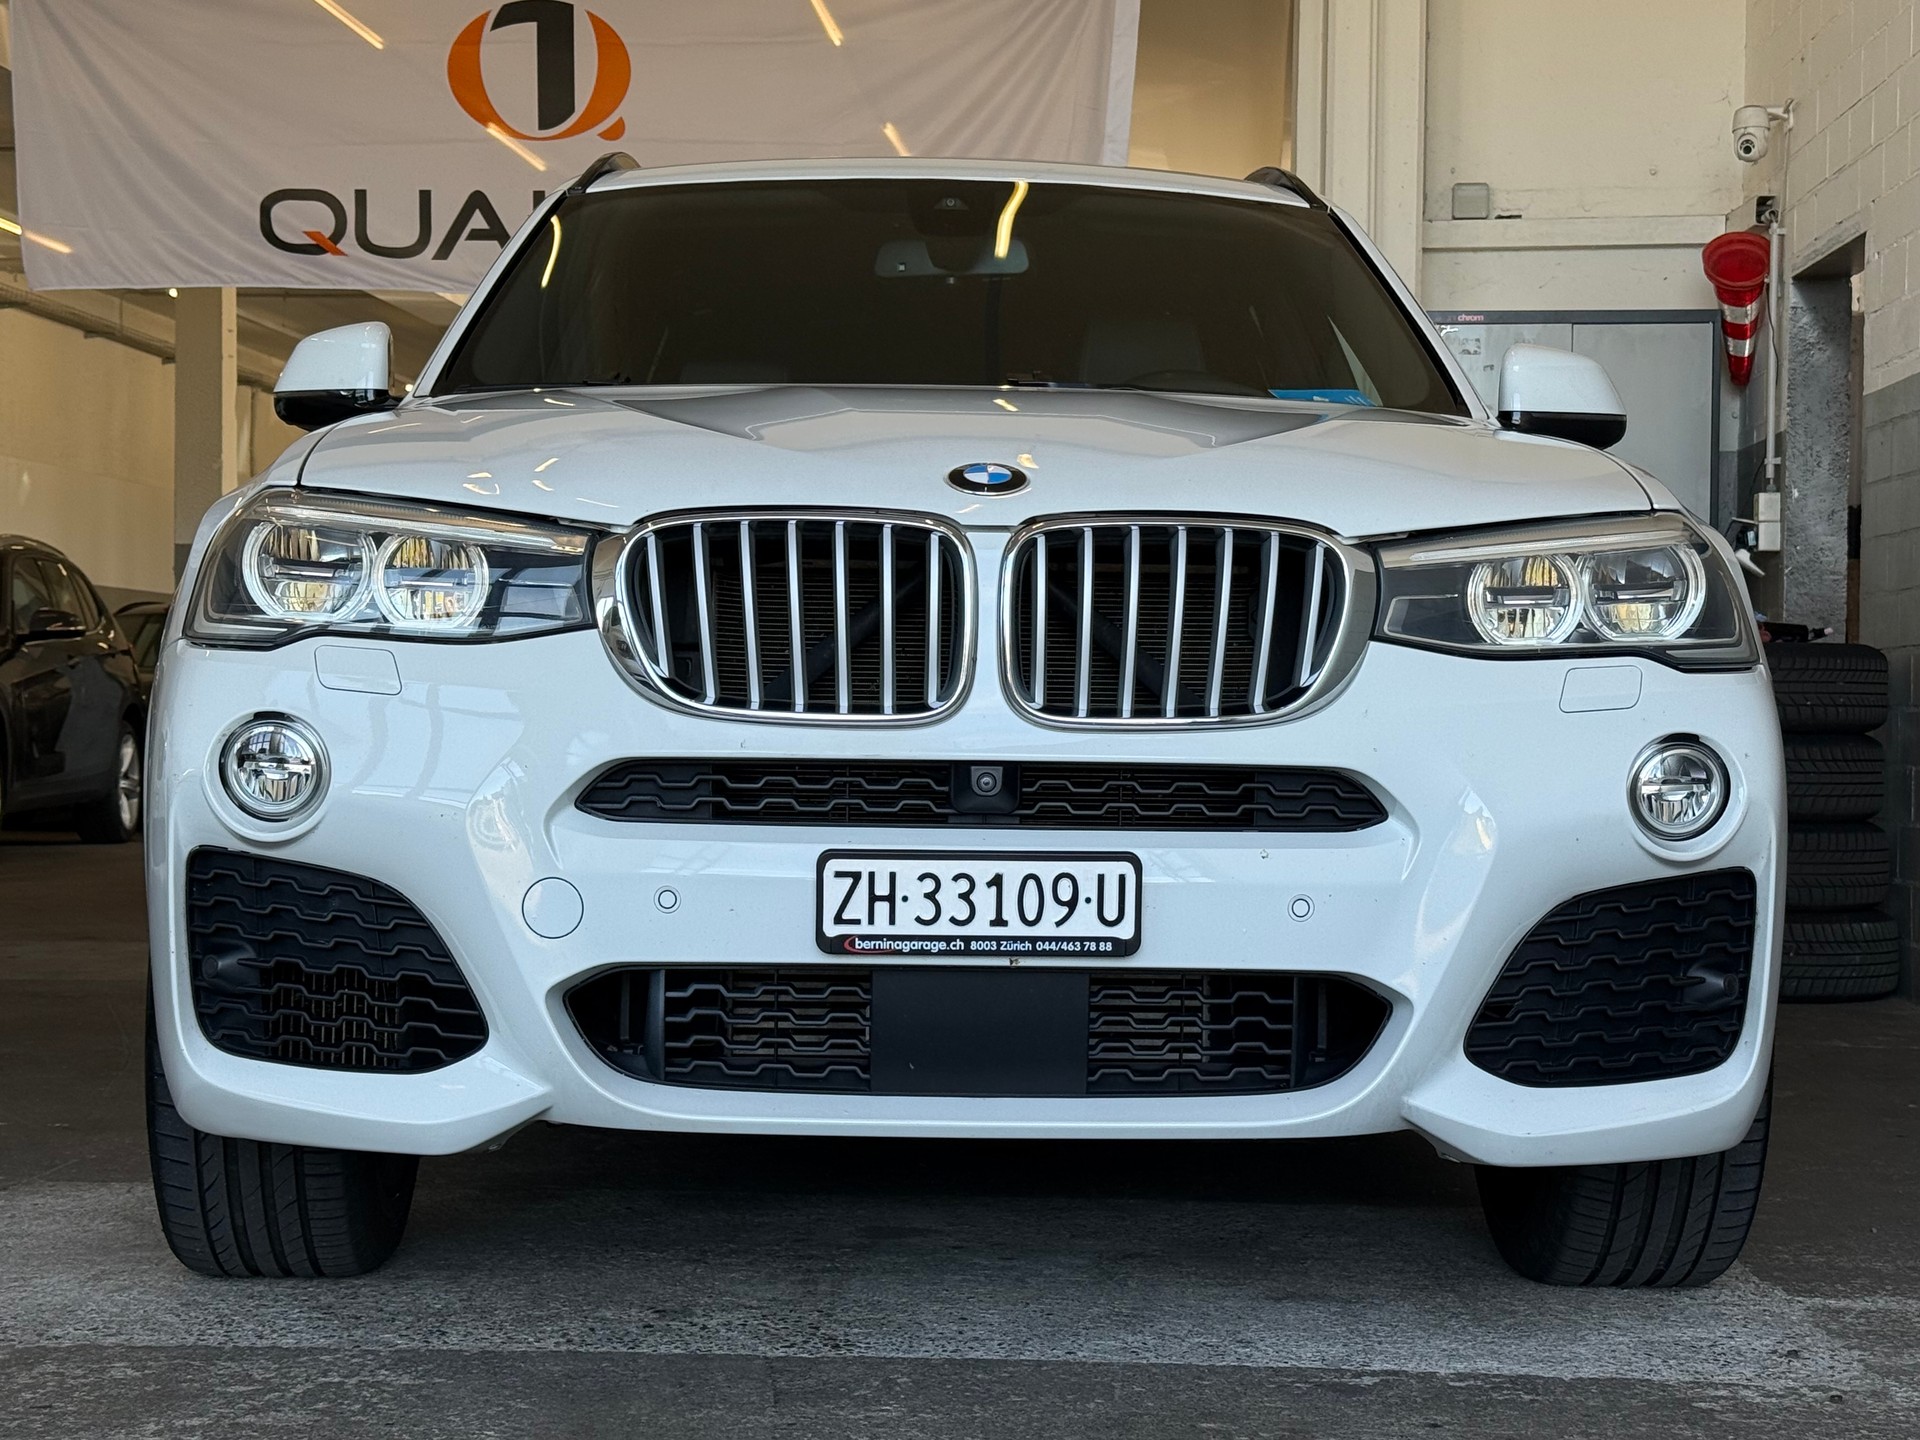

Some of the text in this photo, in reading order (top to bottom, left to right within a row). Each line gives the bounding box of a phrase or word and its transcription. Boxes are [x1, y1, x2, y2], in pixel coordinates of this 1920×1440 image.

[259, 188, 546, 260] QUA
[854, 937, 1113, 953] berninagarage.ch 8003 Zürich 044/463 78 88
